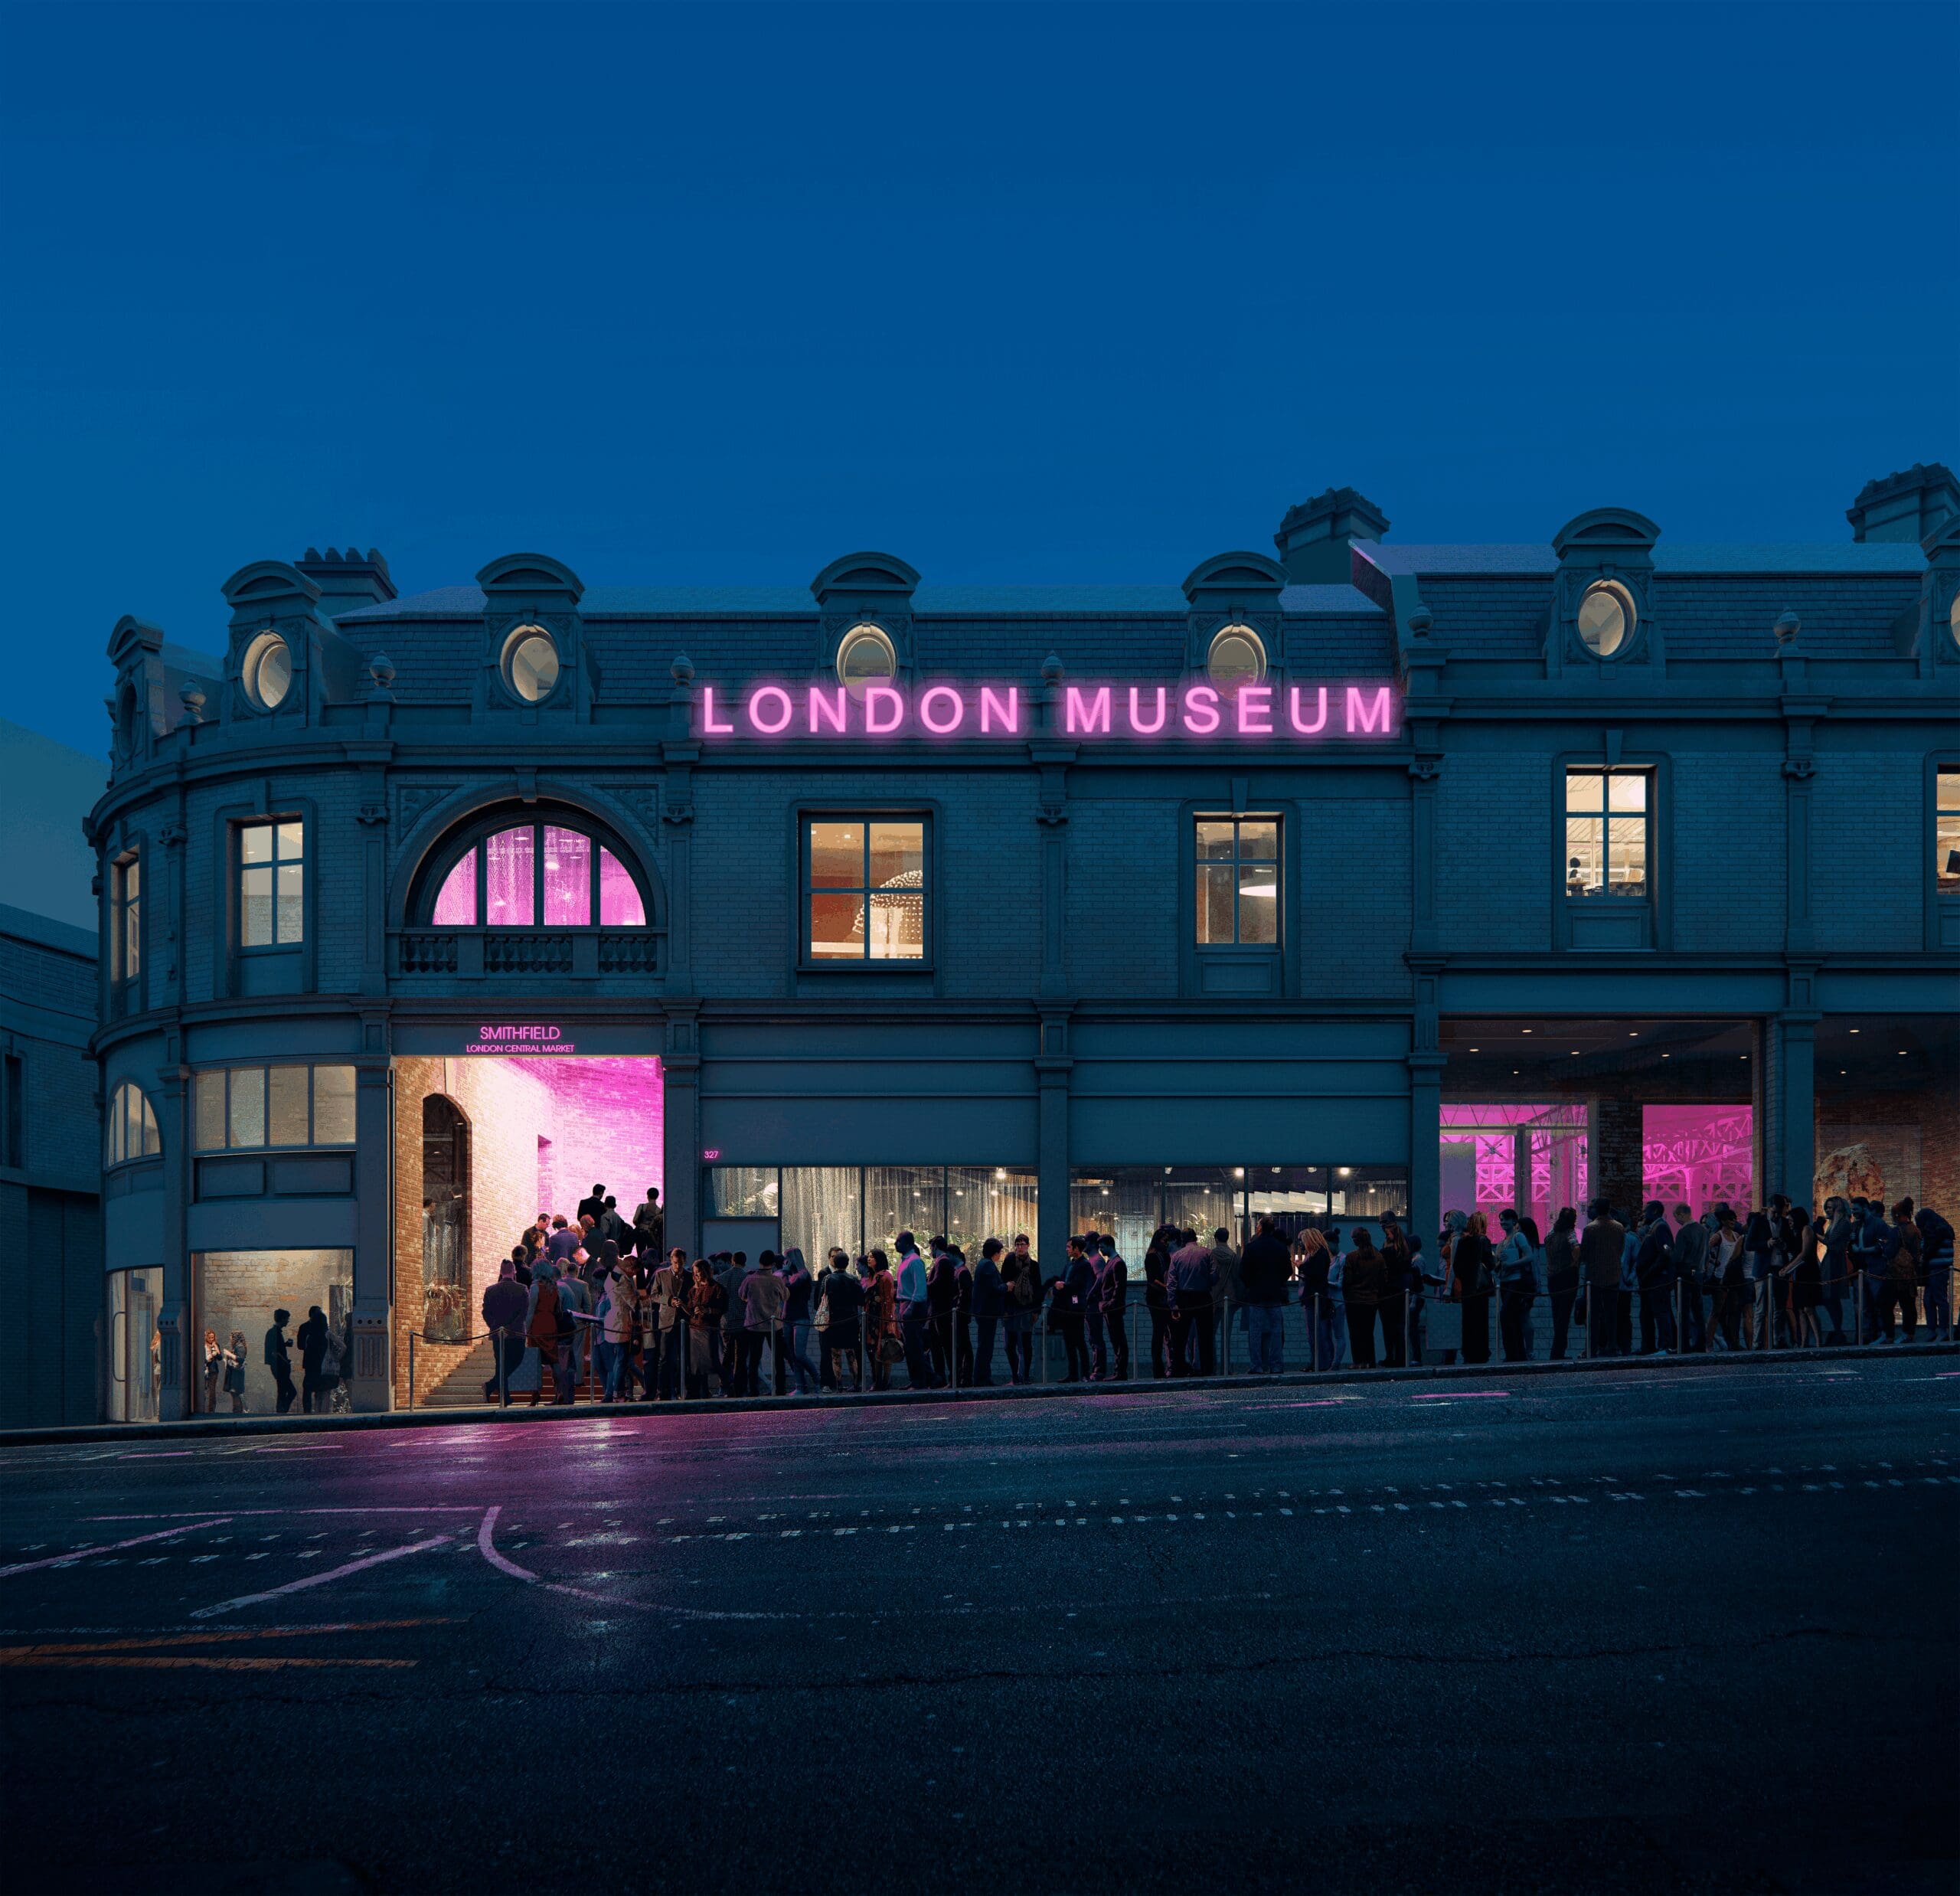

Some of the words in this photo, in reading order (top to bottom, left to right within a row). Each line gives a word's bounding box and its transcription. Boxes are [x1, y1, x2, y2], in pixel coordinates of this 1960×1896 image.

[704, 686, 1018, 734] LONDON
[1067, 686, 1391, 734] MUSEUM
[480, 1026, 560, 1040] SMITHFIELD
[466, 1044, 503, 1053] LONDON
[505, 1044, 541, 1053] CENTRAL
[542, 1044, 575, 1053] MARKET
